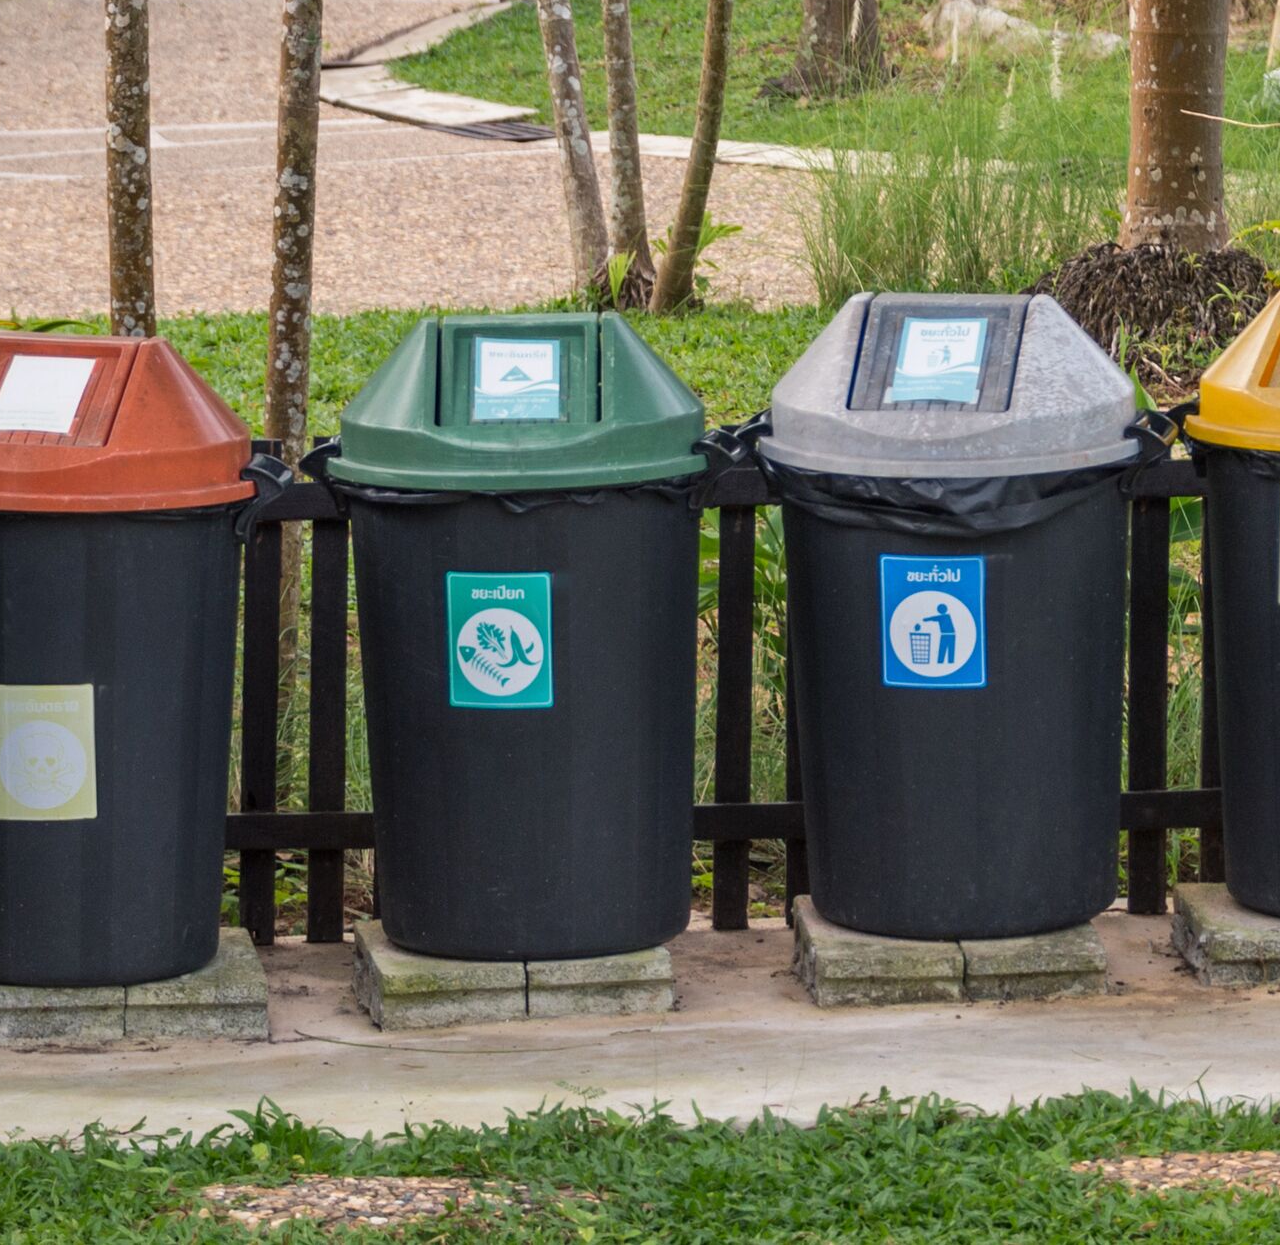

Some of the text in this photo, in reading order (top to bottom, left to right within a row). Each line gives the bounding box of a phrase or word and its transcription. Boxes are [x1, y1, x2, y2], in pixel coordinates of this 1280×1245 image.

[906, 564, 961, 583] ขยะทั่วไป
[471, 584, 525, 600] ขยะเปียก
